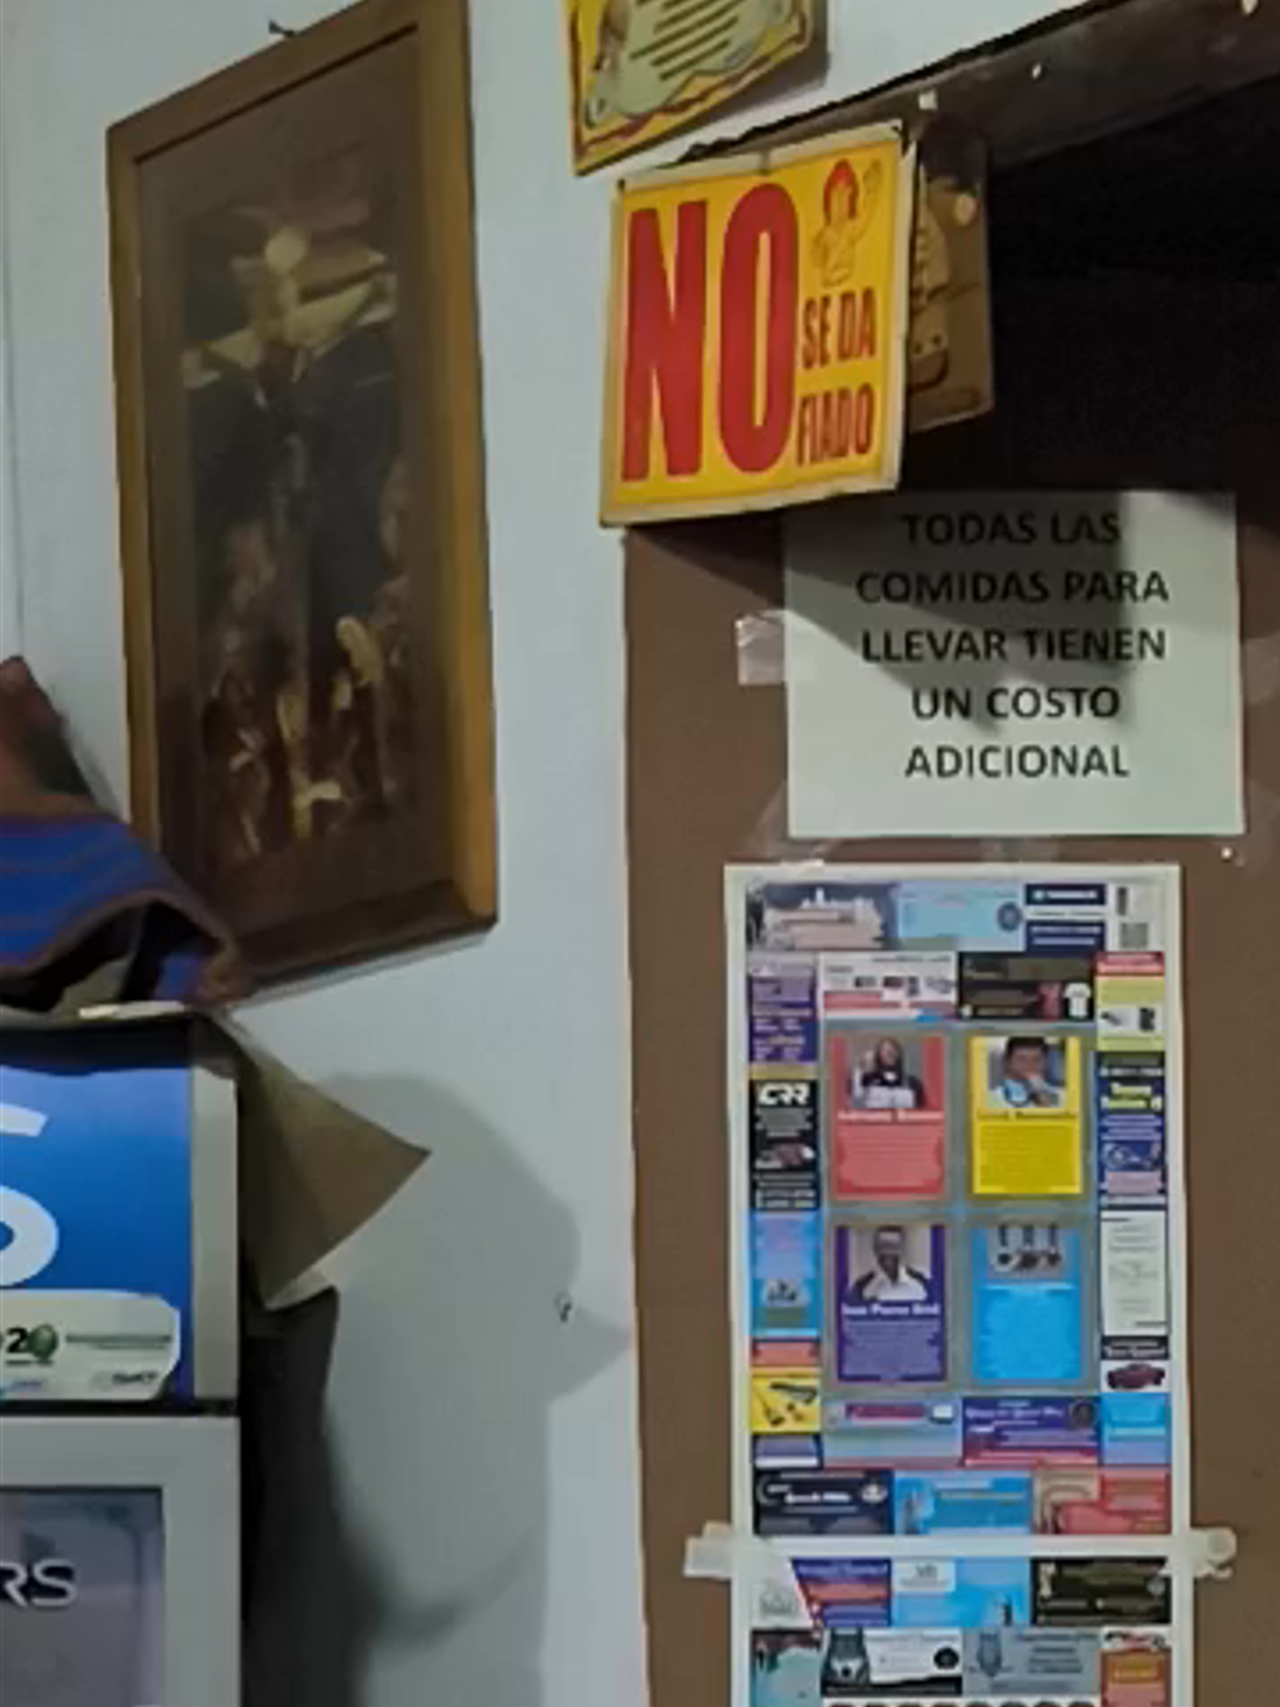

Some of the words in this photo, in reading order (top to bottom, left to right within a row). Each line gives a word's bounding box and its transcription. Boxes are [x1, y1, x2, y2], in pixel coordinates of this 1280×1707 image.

[621, 182, 801, 482] NO
[802, 295, 832, 372] SE
[836, 284, 877, 361] DA
[796, 382, 876, 470] FIADO
[902, 511, 1038, 546] TODAS
[1050, 511, 1121, 545] LAS
[854, 569, 1050, 606] COMIDAS
[1062, 569, 1170, 605] PARA
[861, 628, 1009, 663] LLEVAR
[1022, 628, 1166, 662] TIENEN
[911, 686, 972, 720] UN
[985, 685, 1121, 721] COSTO
[904, 743, 1131, 779] ADICIONAL
